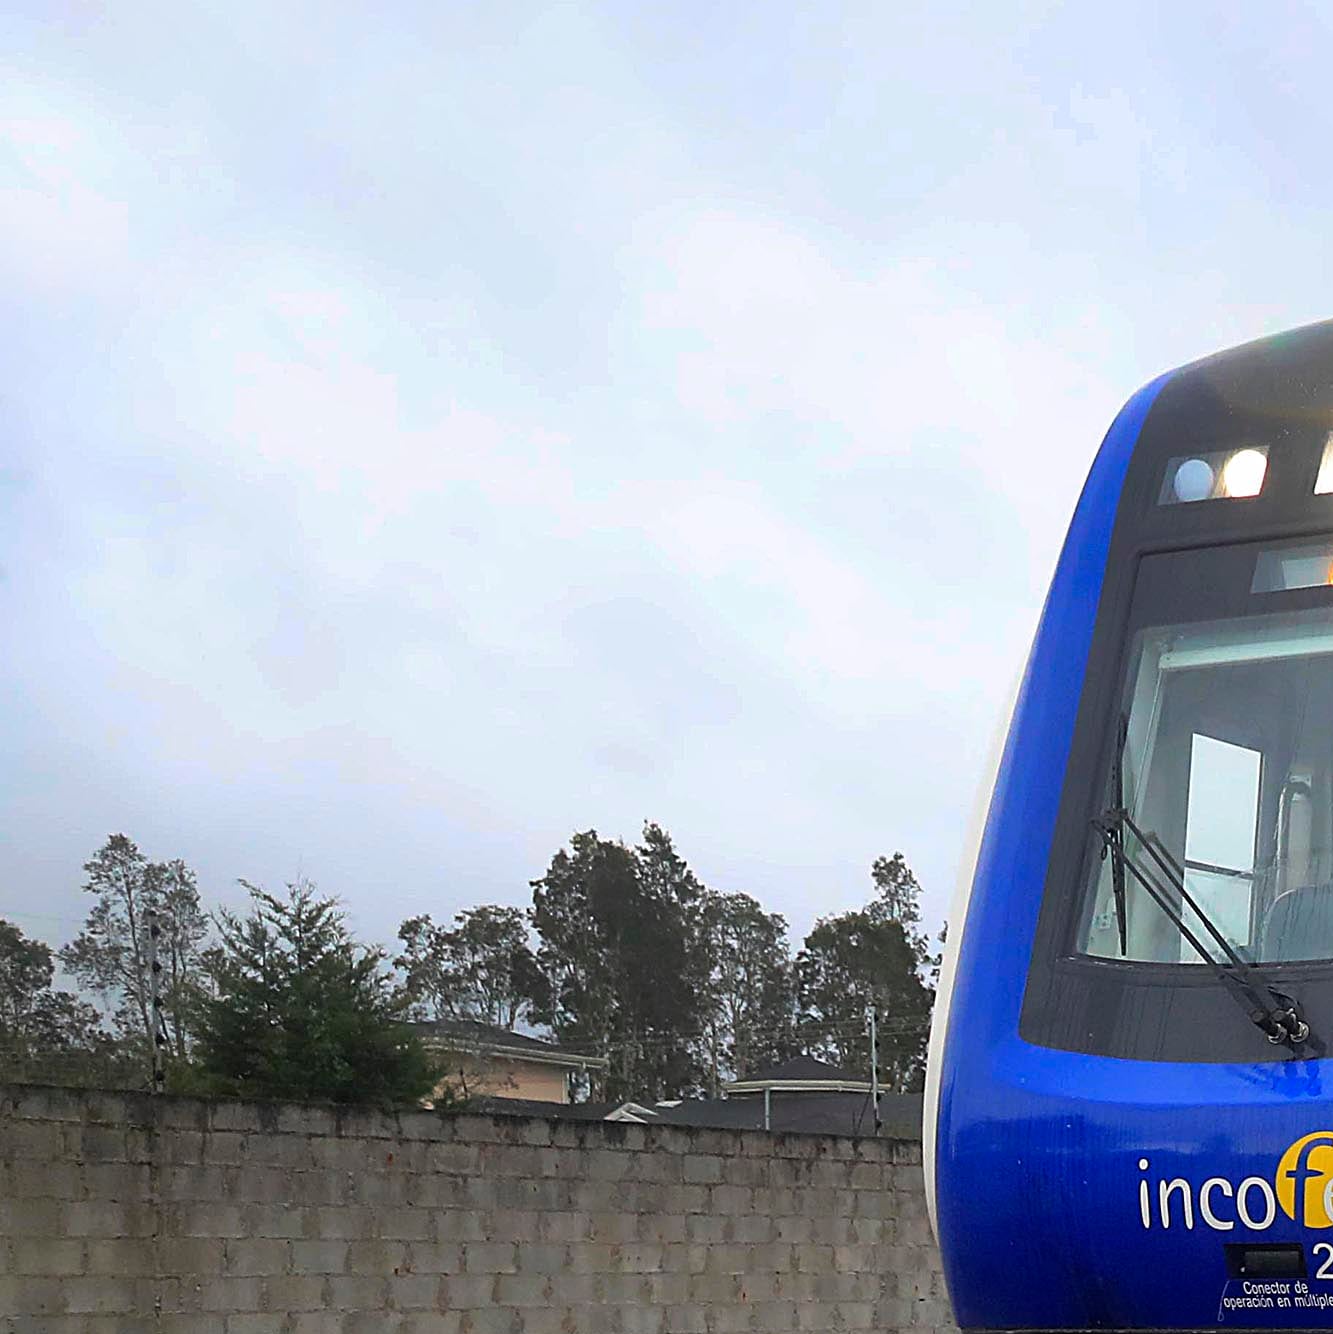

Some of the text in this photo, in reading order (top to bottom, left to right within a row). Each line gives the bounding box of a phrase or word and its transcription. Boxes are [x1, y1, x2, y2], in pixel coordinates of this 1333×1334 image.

[1242, 1280, 1309, 1295] Conector de
[1223, 1294, 1274, 1311] operación
[1277, 1296, 1292, 1308] en
